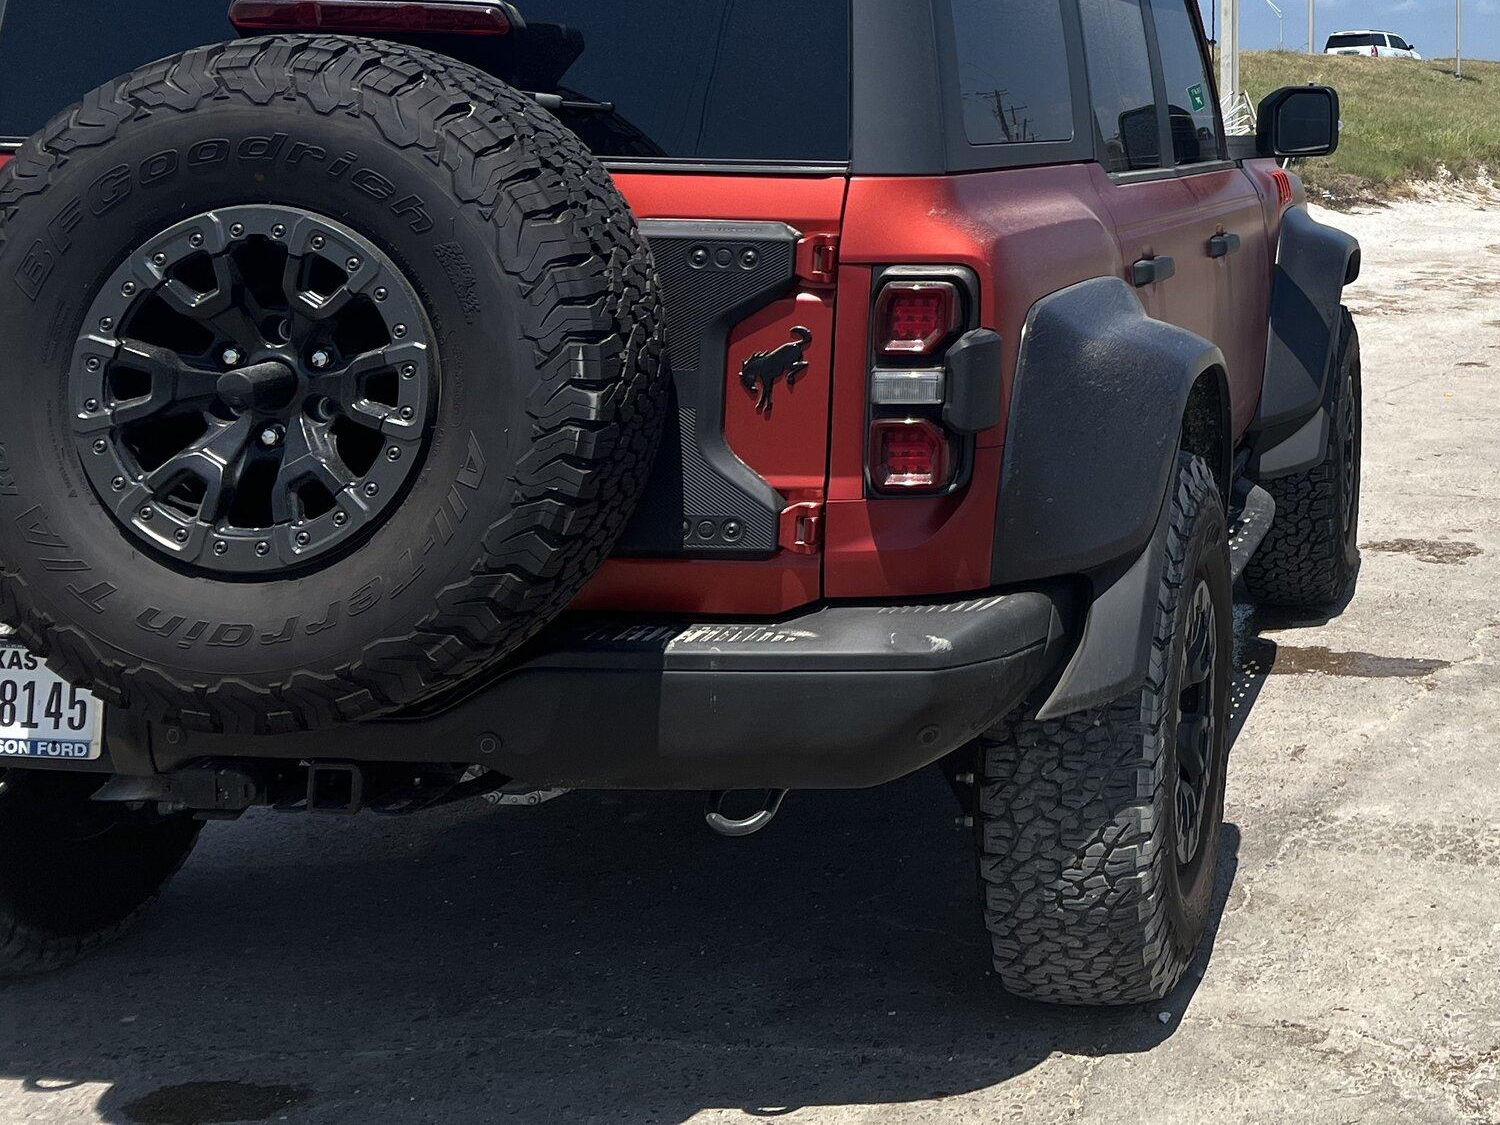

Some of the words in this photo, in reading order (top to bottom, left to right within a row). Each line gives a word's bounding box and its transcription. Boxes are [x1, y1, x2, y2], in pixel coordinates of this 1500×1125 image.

[14, 131, 435, 301] BFGoodrich
[0, 679, 87, 731] 8145
[37, 742, 87, 757] FORD
